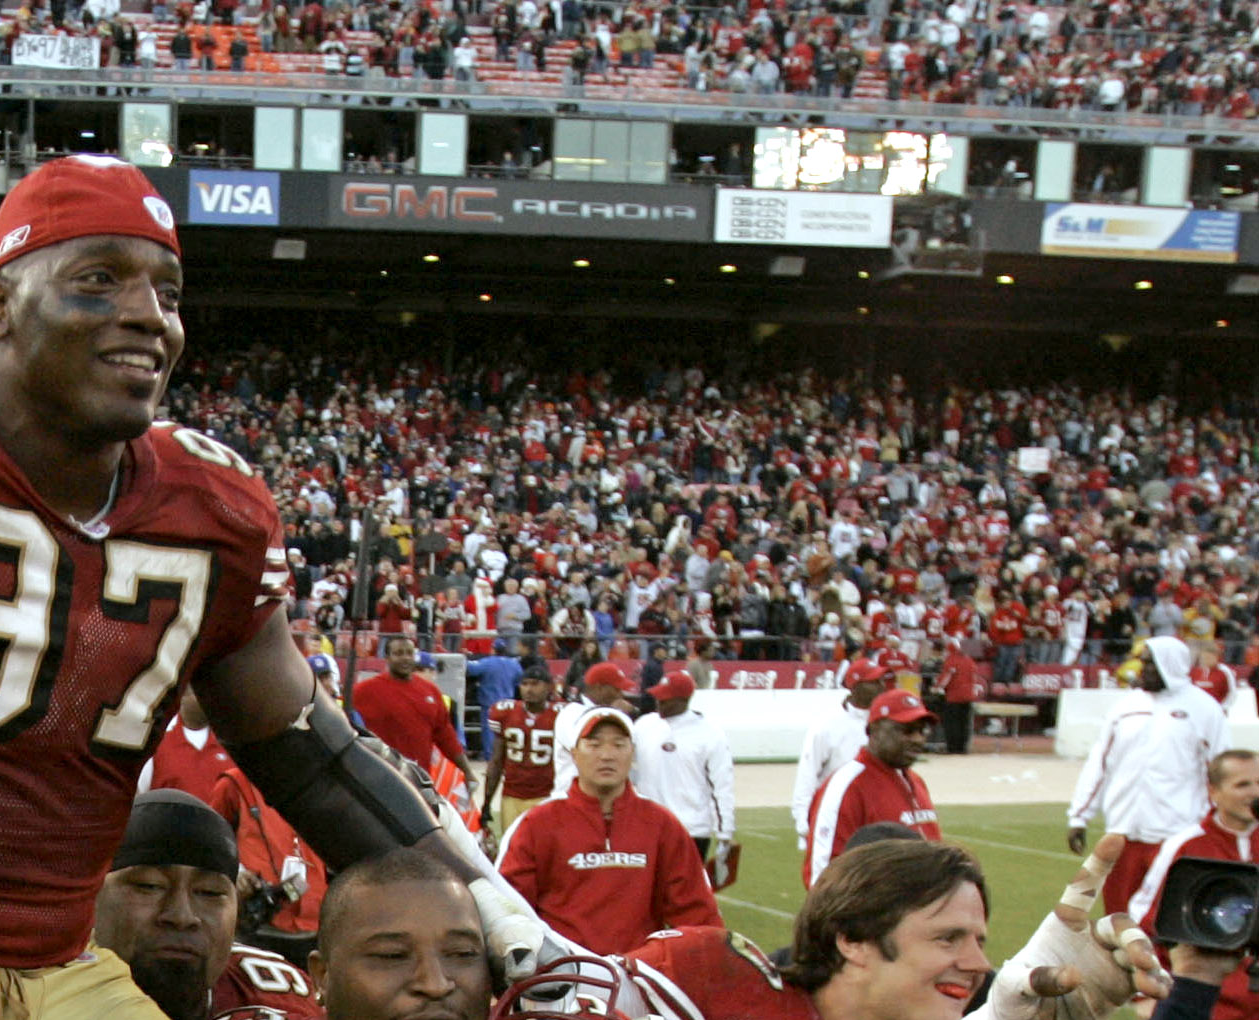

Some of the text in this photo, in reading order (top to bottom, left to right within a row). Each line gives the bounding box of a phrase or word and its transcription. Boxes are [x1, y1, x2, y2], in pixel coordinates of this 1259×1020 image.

[196, 182, 274, 215] VISA
[343, 182, 498, 222] GMC
[513, 199, 696, 221] ACADIA
[504, 728, 554, 764] 25
[568, 852, 647, 869] 49ERS
